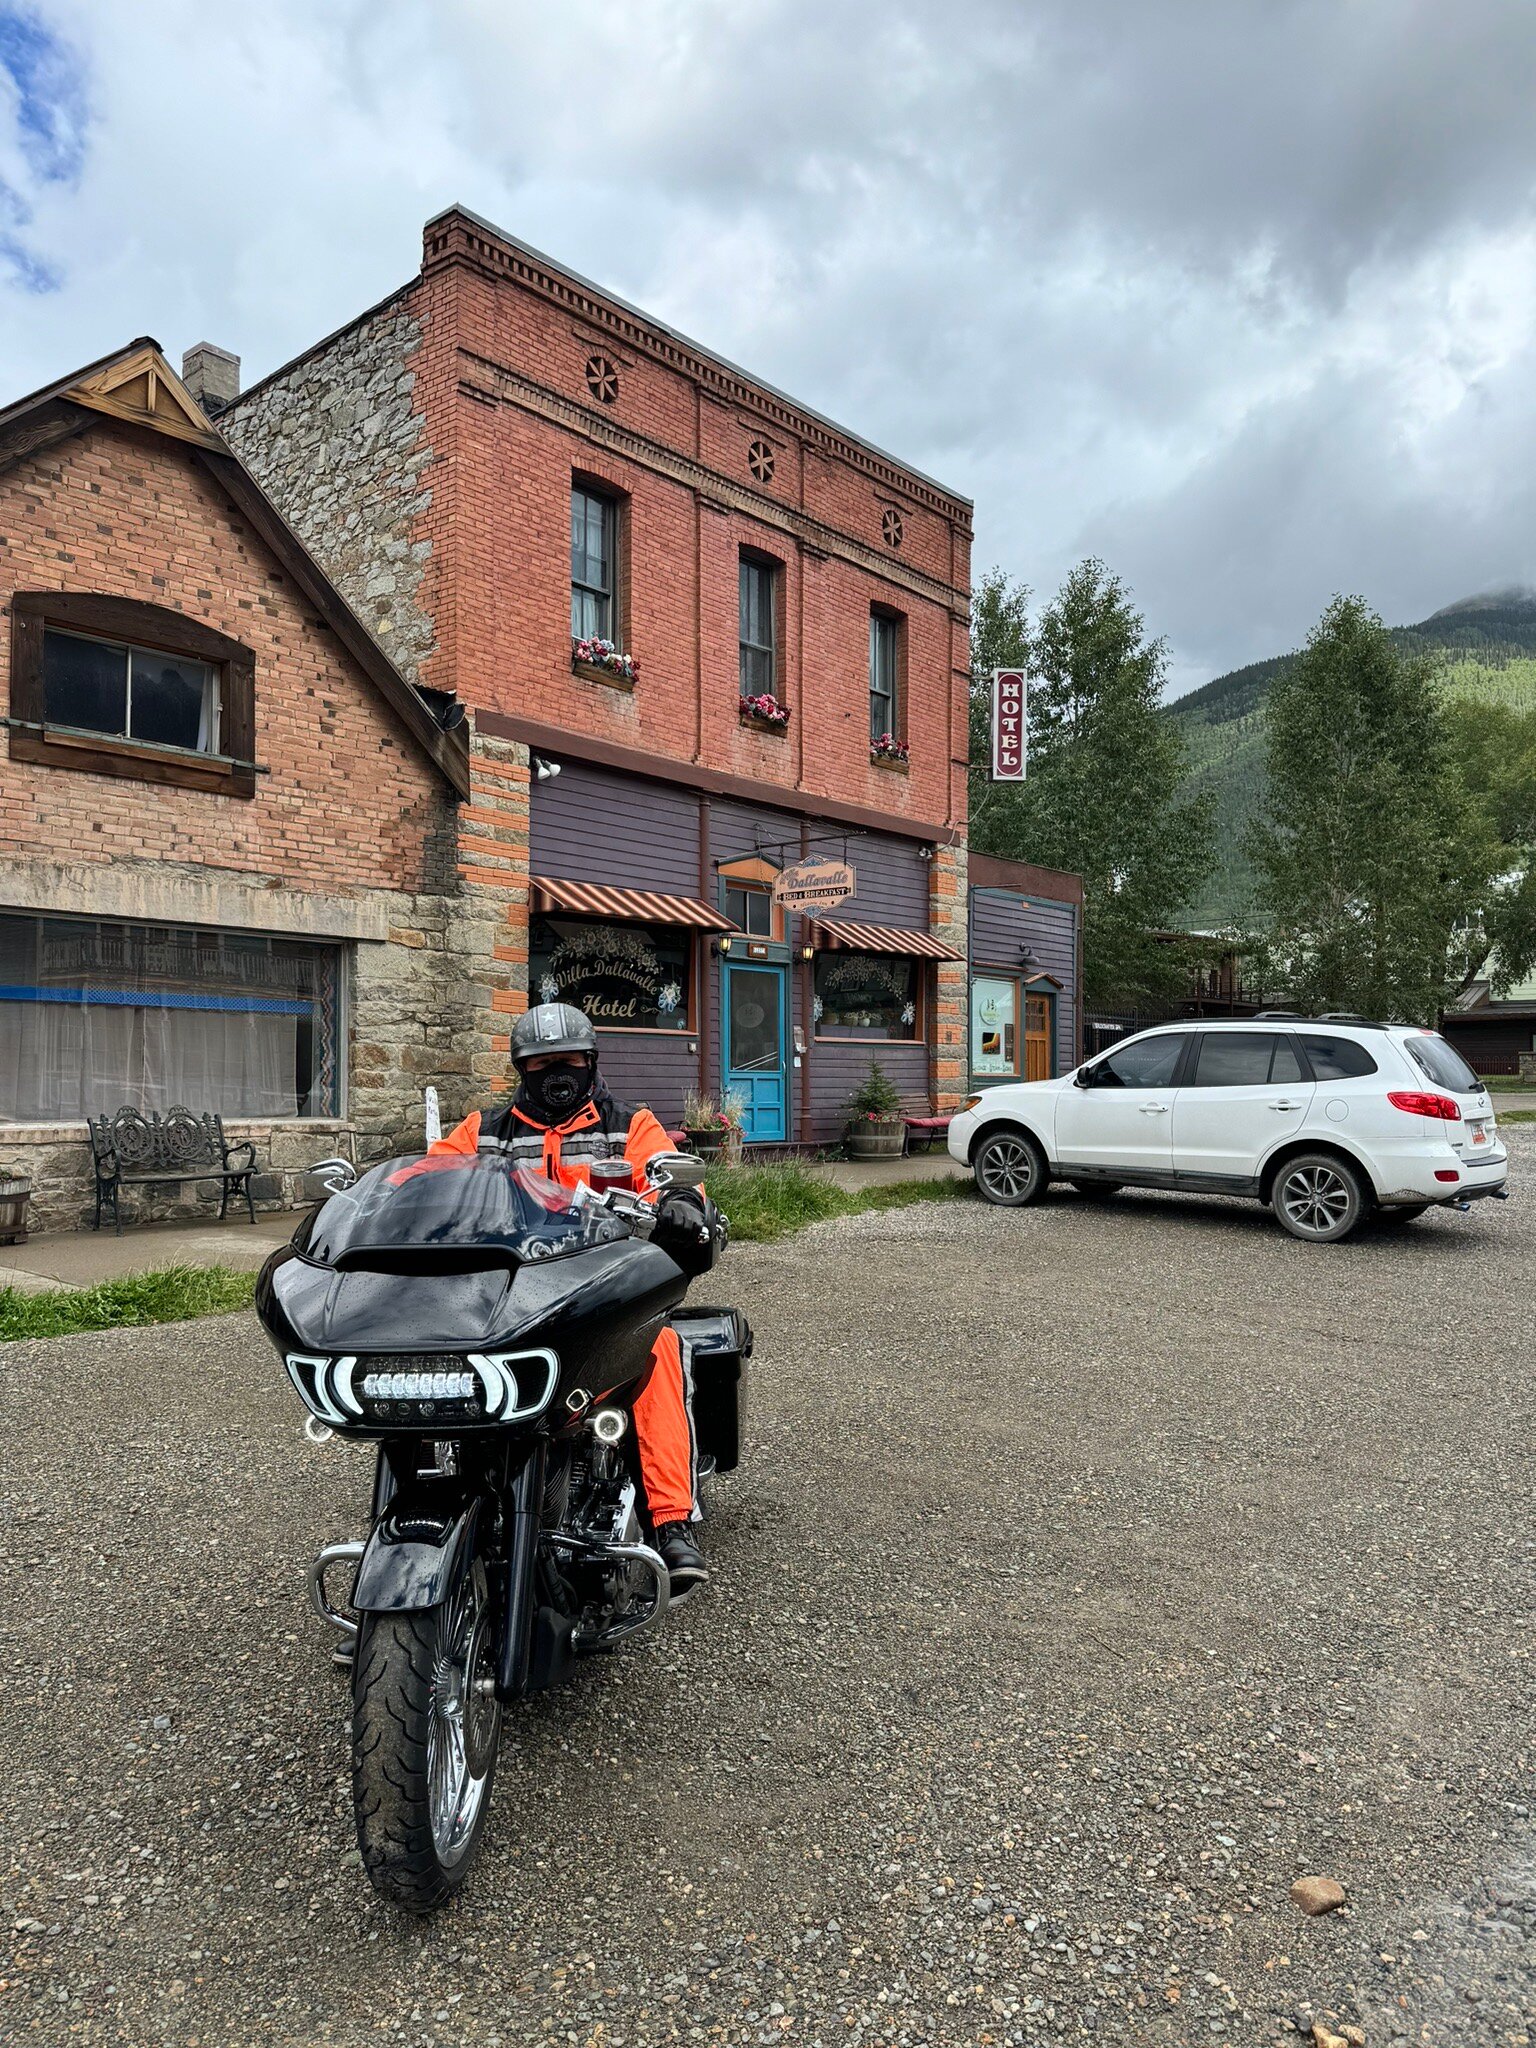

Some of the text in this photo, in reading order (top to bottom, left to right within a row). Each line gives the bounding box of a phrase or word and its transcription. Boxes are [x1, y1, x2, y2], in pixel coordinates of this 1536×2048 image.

[1002, 683, 1019, 766] HOTEL
[788, 871, 848, 889] Dallavalle
[804, 887, 846, 898] BREAKFAST
[556, 960, 657, 995] Villa Dallavalle
[583, 994, 637, 1018] Hotel
